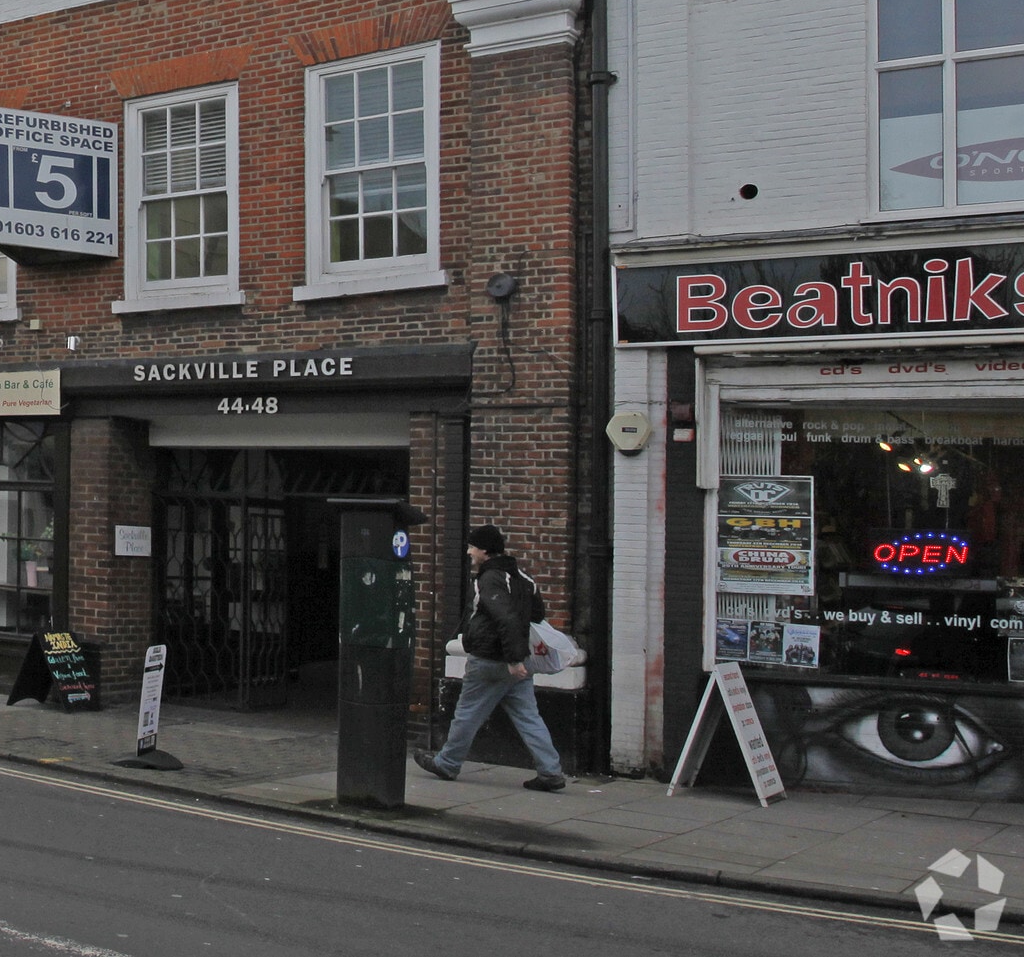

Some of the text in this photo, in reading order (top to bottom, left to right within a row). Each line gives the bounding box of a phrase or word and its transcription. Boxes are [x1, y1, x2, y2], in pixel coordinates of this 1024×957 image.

[60, 135, 114, 152] SPACE
[50, 226, 81, 242] 616
[86, 231, 114, 245] 221
[133, 357, 353, 382] SACKVILLE PLACE
[820, 359, 1024, 376] cd's dvd's vide
[4, 379, 20, 389] Bar
[23, 379, 29, 389] &
[32, 378, 54, 389] Café
[18, 399, 53, 407] Vegetarian
[734, 418, 793, 429] alternative
[802, 420, 828, 430] rock
[830, 421, 839, 430] &
[806, 432, 832, 443] funk
[841, 433, 871, 443] drum
[887, 435, 914, 445] bass
[924, 435, 983, 445] breakbeat
[726, 517, 801, 528] GBH
[874, 544, 969, 564] OPEN
[823, 611, 845, 621] we
[848, 609, 876, 625] buy
[880, 611, 892, 623] &
[896, 612, 923, 625] sell
[944, 614, 981, 631] vinyl
